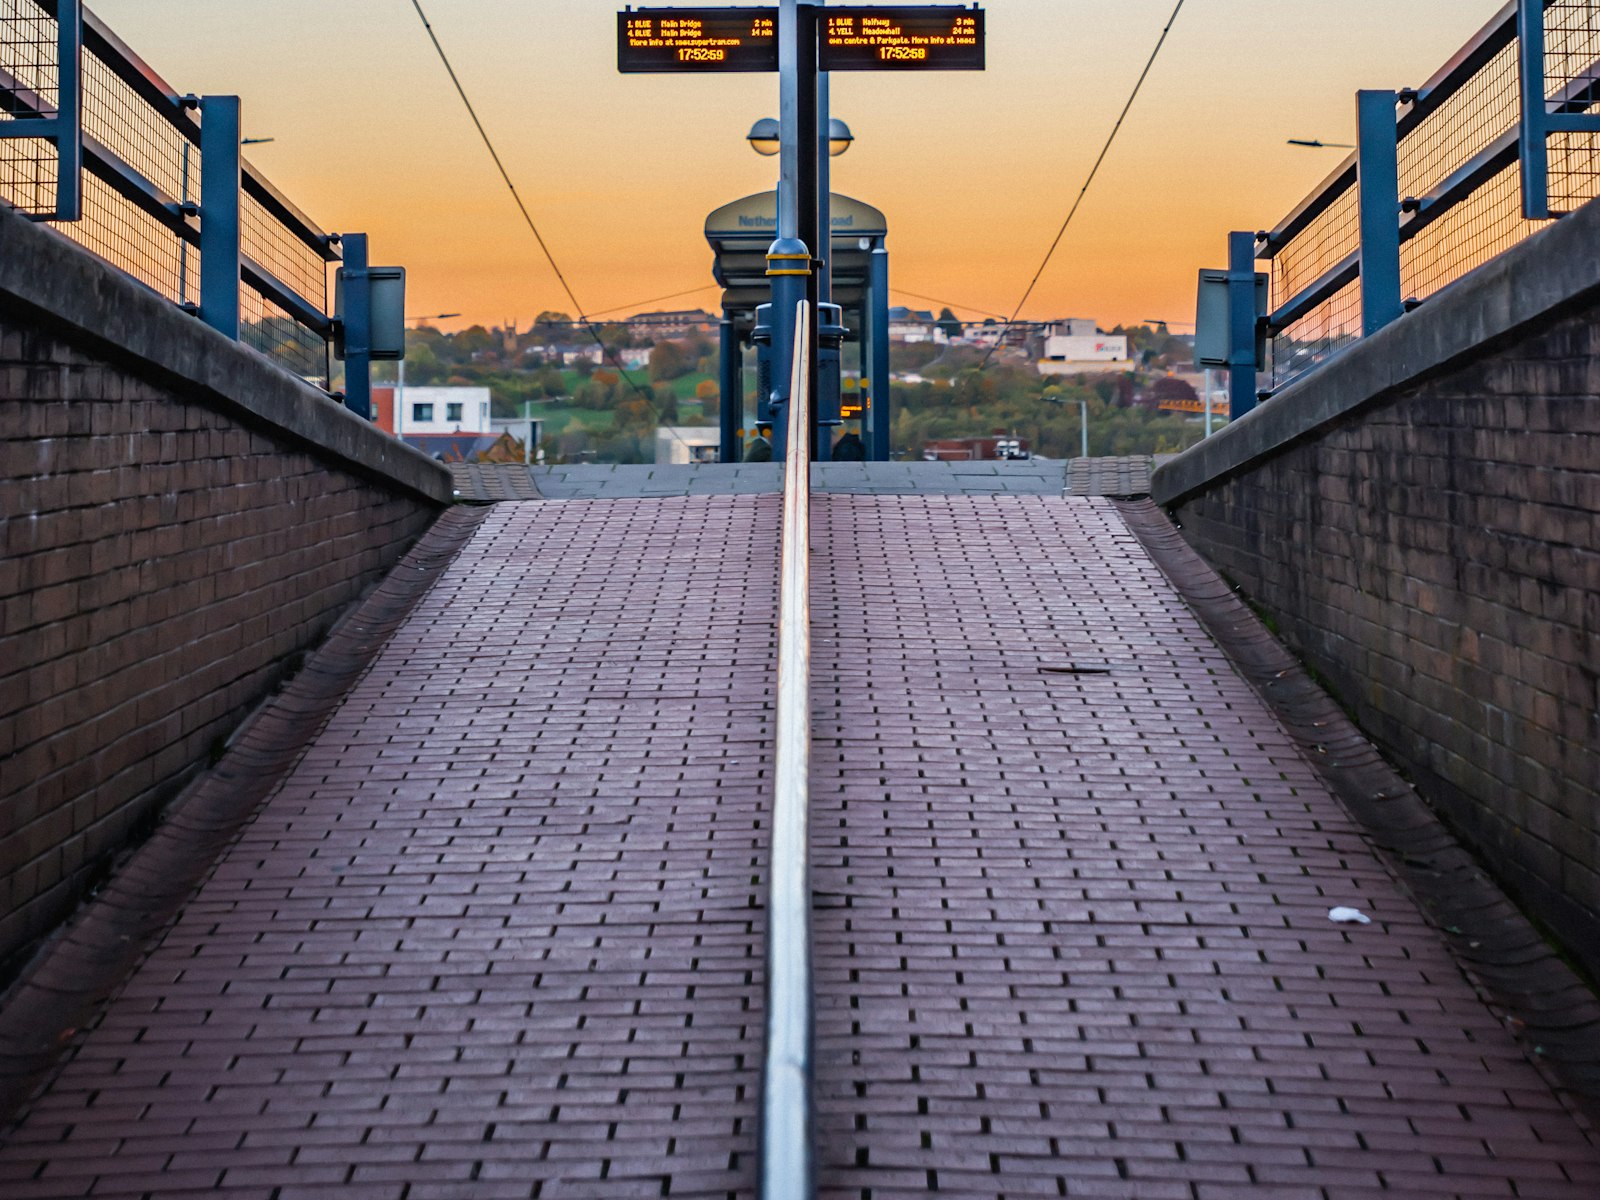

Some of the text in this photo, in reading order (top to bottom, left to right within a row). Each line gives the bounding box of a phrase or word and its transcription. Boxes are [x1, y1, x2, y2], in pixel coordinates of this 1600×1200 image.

[635, 20, 651, 28] BLUE
[680, 20, 701, 29] Bridge
[754, 19, 760, 27] 2
[761, 19, 773, 27] min
[836, 18, 853, 26] BLUE
[862, 18, 890, 27] Halfway
[956, 17, 962, 25] 3
[963, 17, 975, 25] min
[635, 29, 651, 37] BLUE
[680, 29, 701, 38] Bridge
[751, 28, 760, 36] 14
[761, 28, 773, 36] min
[836, 27, 853, 35] YELL
[862, 27, 900, 35] Meadowhall
[952, 27, 962, 35] 24
[963, 27, 975, 35] min
[629, 38, 648, 46] More
[649, 38, 663, 46] info
[665, 38, 674, 46] at
[844, 37, 868, 45] centre
[911, 36, 929, 44] More
[930, 36, 944, 44] info
[946, 36, 955, 44] at
[738, 215, 853, 226] Nether oad
